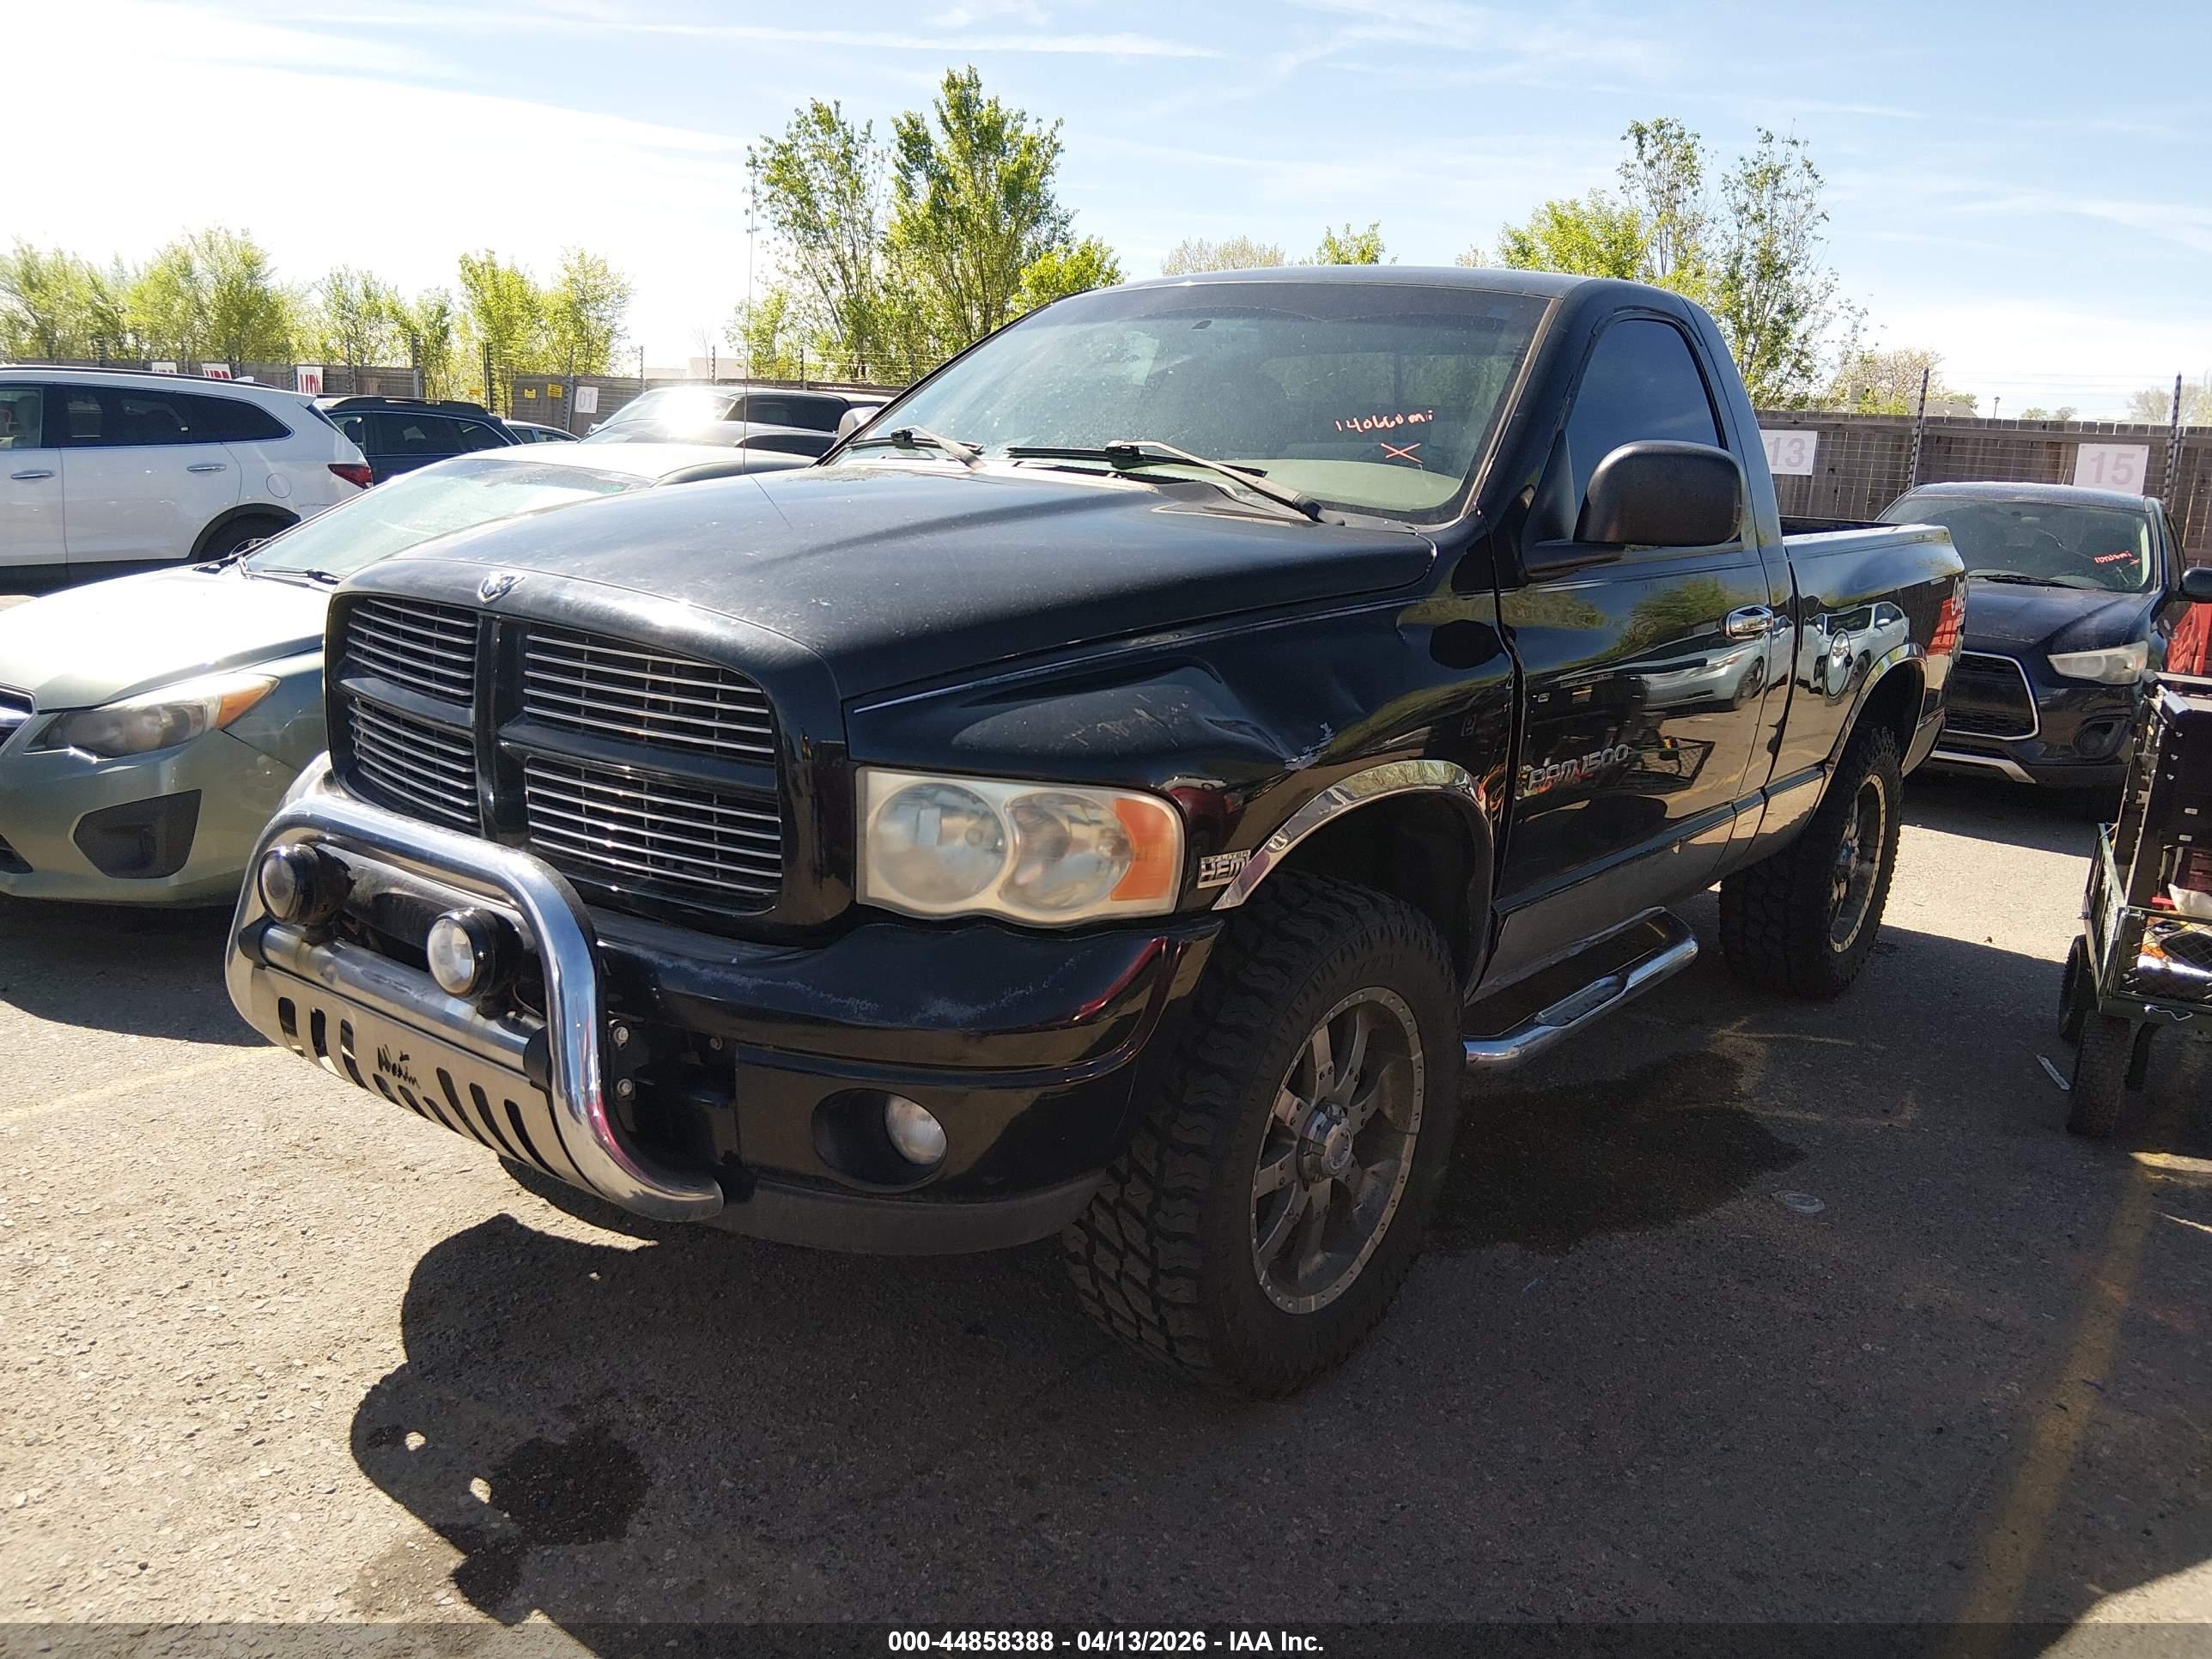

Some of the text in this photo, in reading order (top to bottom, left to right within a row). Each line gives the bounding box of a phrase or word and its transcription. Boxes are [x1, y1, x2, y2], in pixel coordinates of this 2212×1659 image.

[1407, 410, 1434, 424] mi
[1767, 436, 1806, 468] 13
[2090, 452, 2136, 485] 15
[1581, 744, 1629, 775] 1500
